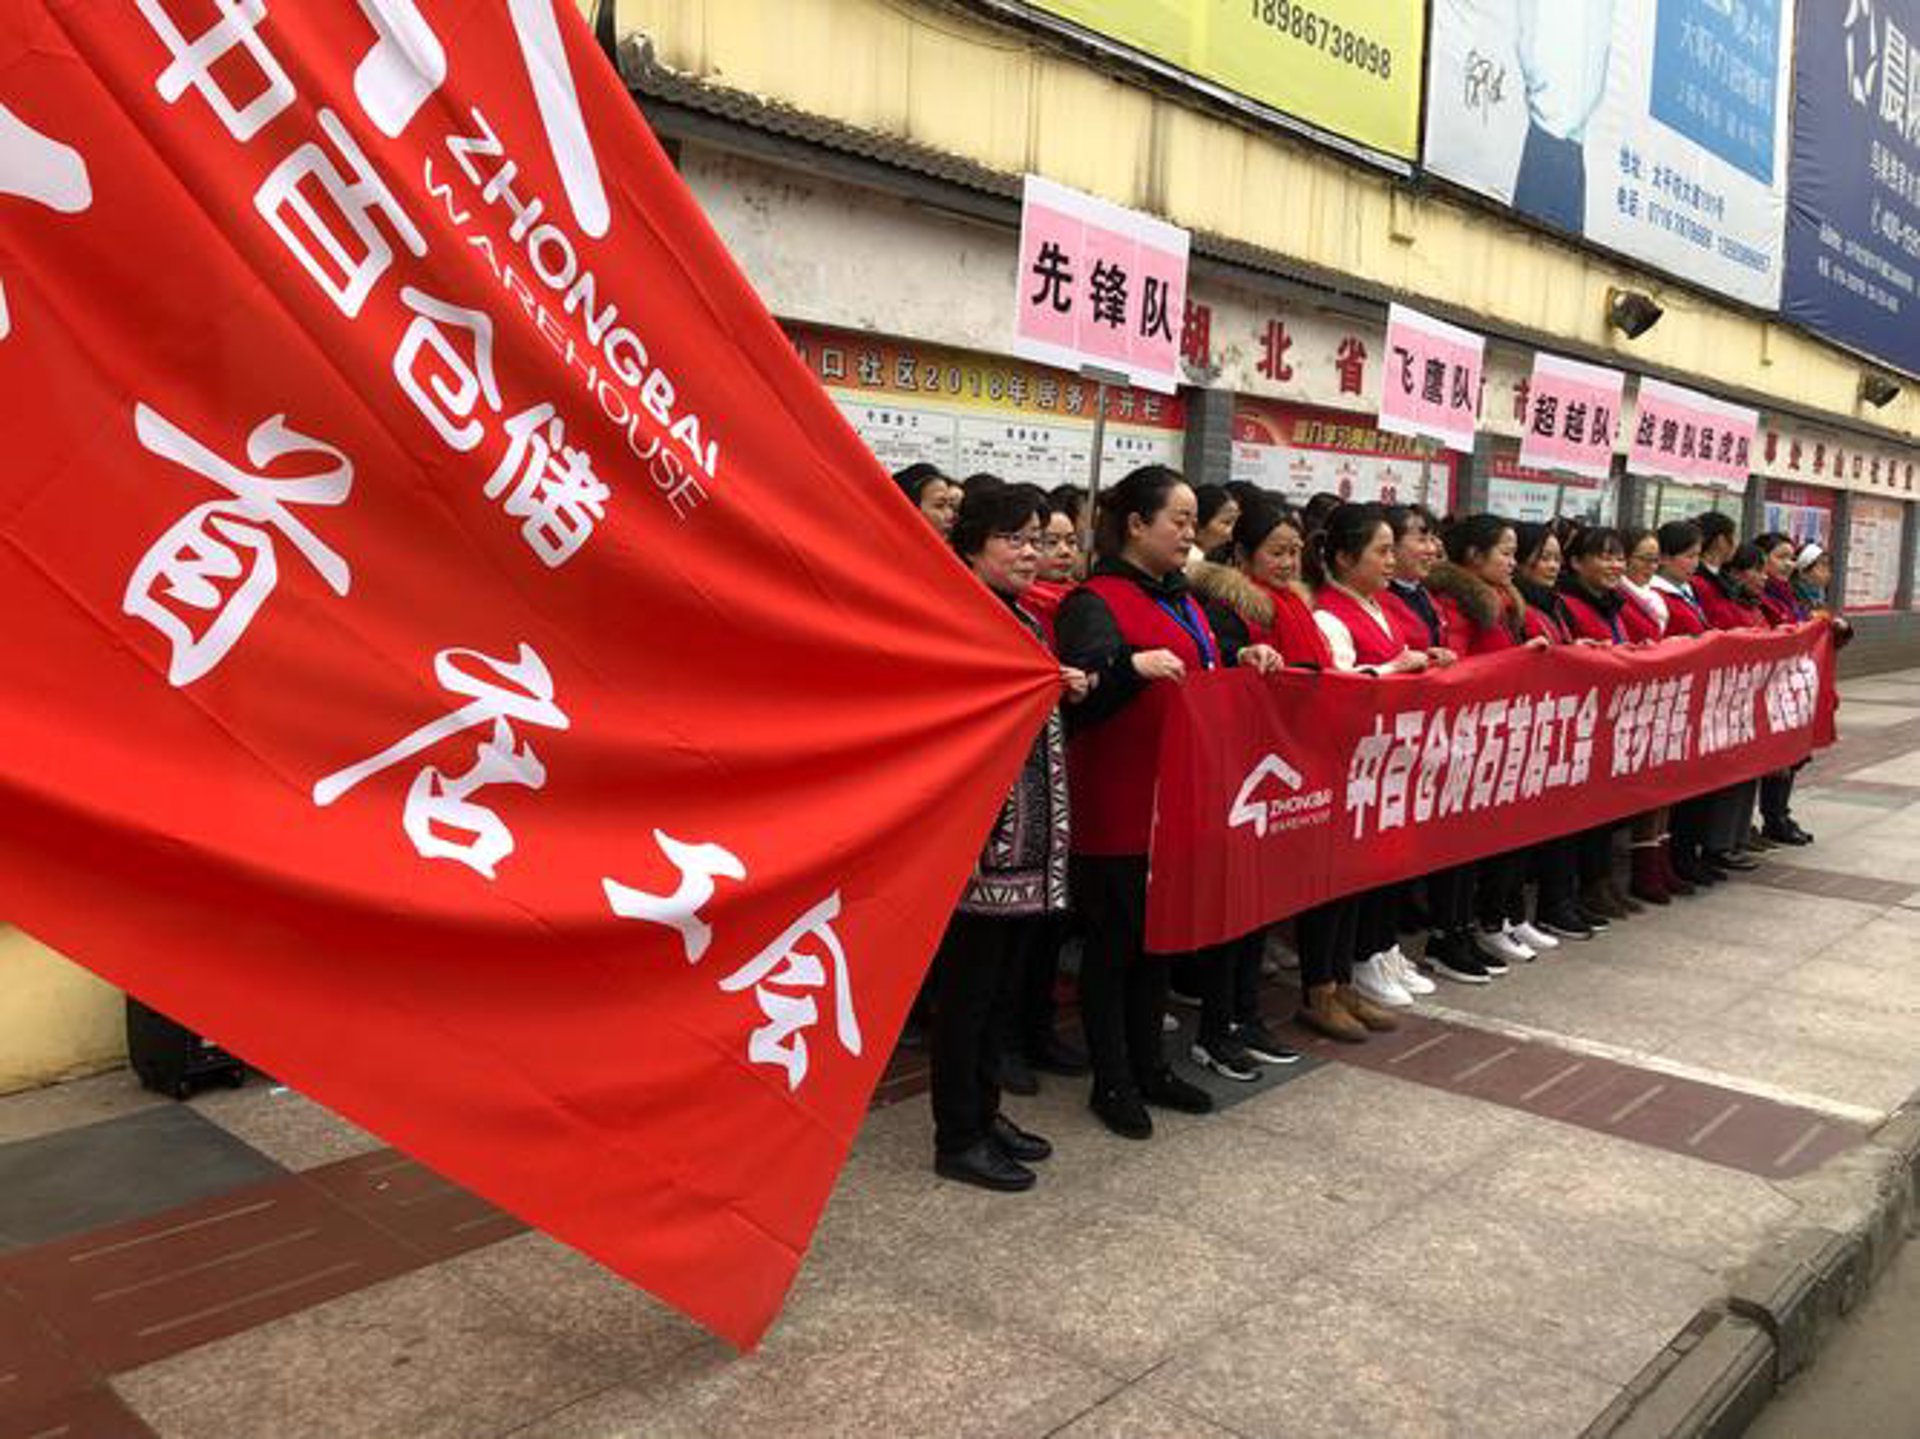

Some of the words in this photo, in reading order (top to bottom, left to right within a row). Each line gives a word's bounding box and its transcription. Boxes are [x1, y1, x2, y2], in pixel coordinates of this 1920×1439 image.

[1250, 0, 1392, 80] 18986738098
[423, 158, 708, 520] WAREHOUSE
[446, 106, 718, 478] ZHONGBAI
[1031, 241, 1173, 343] 先锋队
[1393, 346, 1473, 412] 飞鹰队
[1531, 393, 1611, 447] 超越队
[1346, 687, 1599, 839] 中百仓储石首店工会
